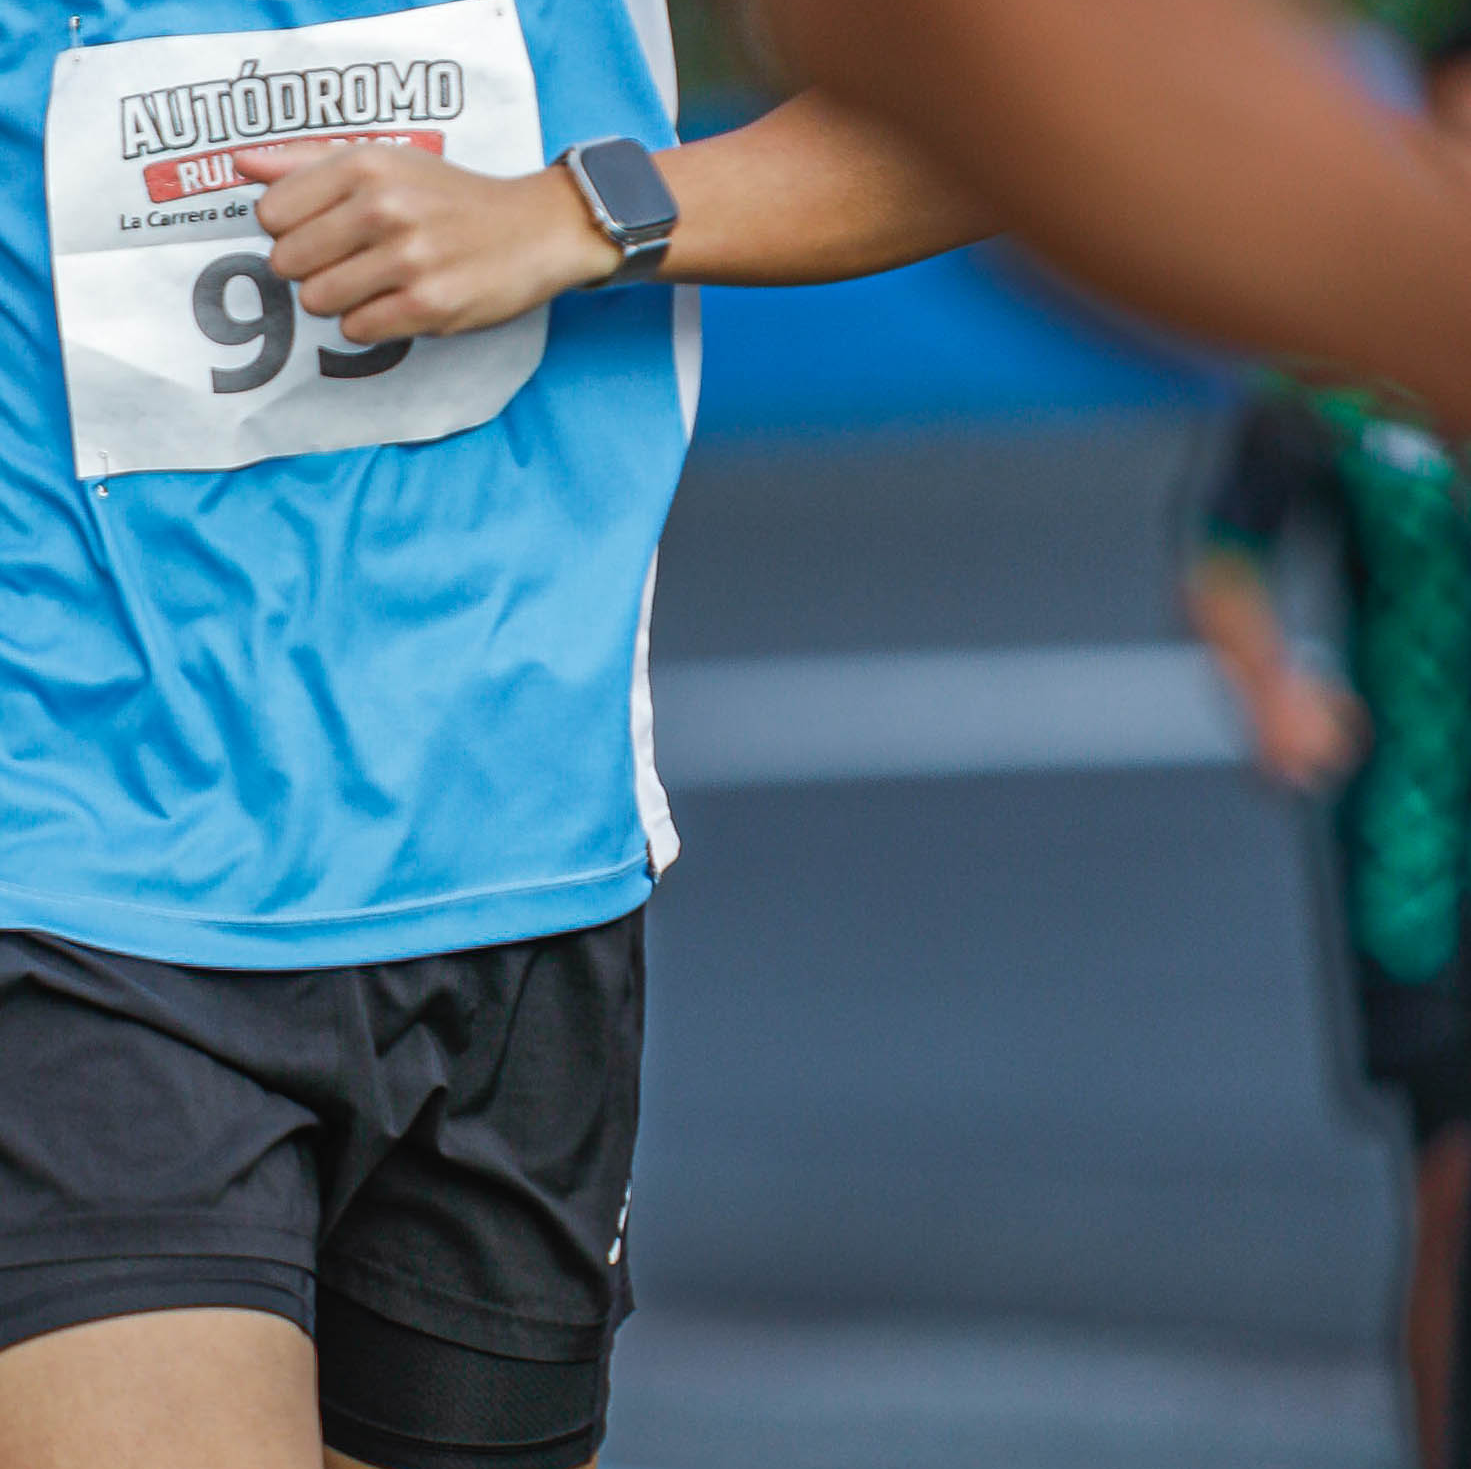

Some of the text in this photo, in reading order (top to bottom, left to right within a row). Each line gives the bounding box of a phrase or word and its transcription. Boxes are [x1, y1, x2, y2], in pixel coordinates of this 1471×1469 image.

[121, 59, 465, 159] AUTÓDROMO
[120, 201, 249, 231] La Carrera de
